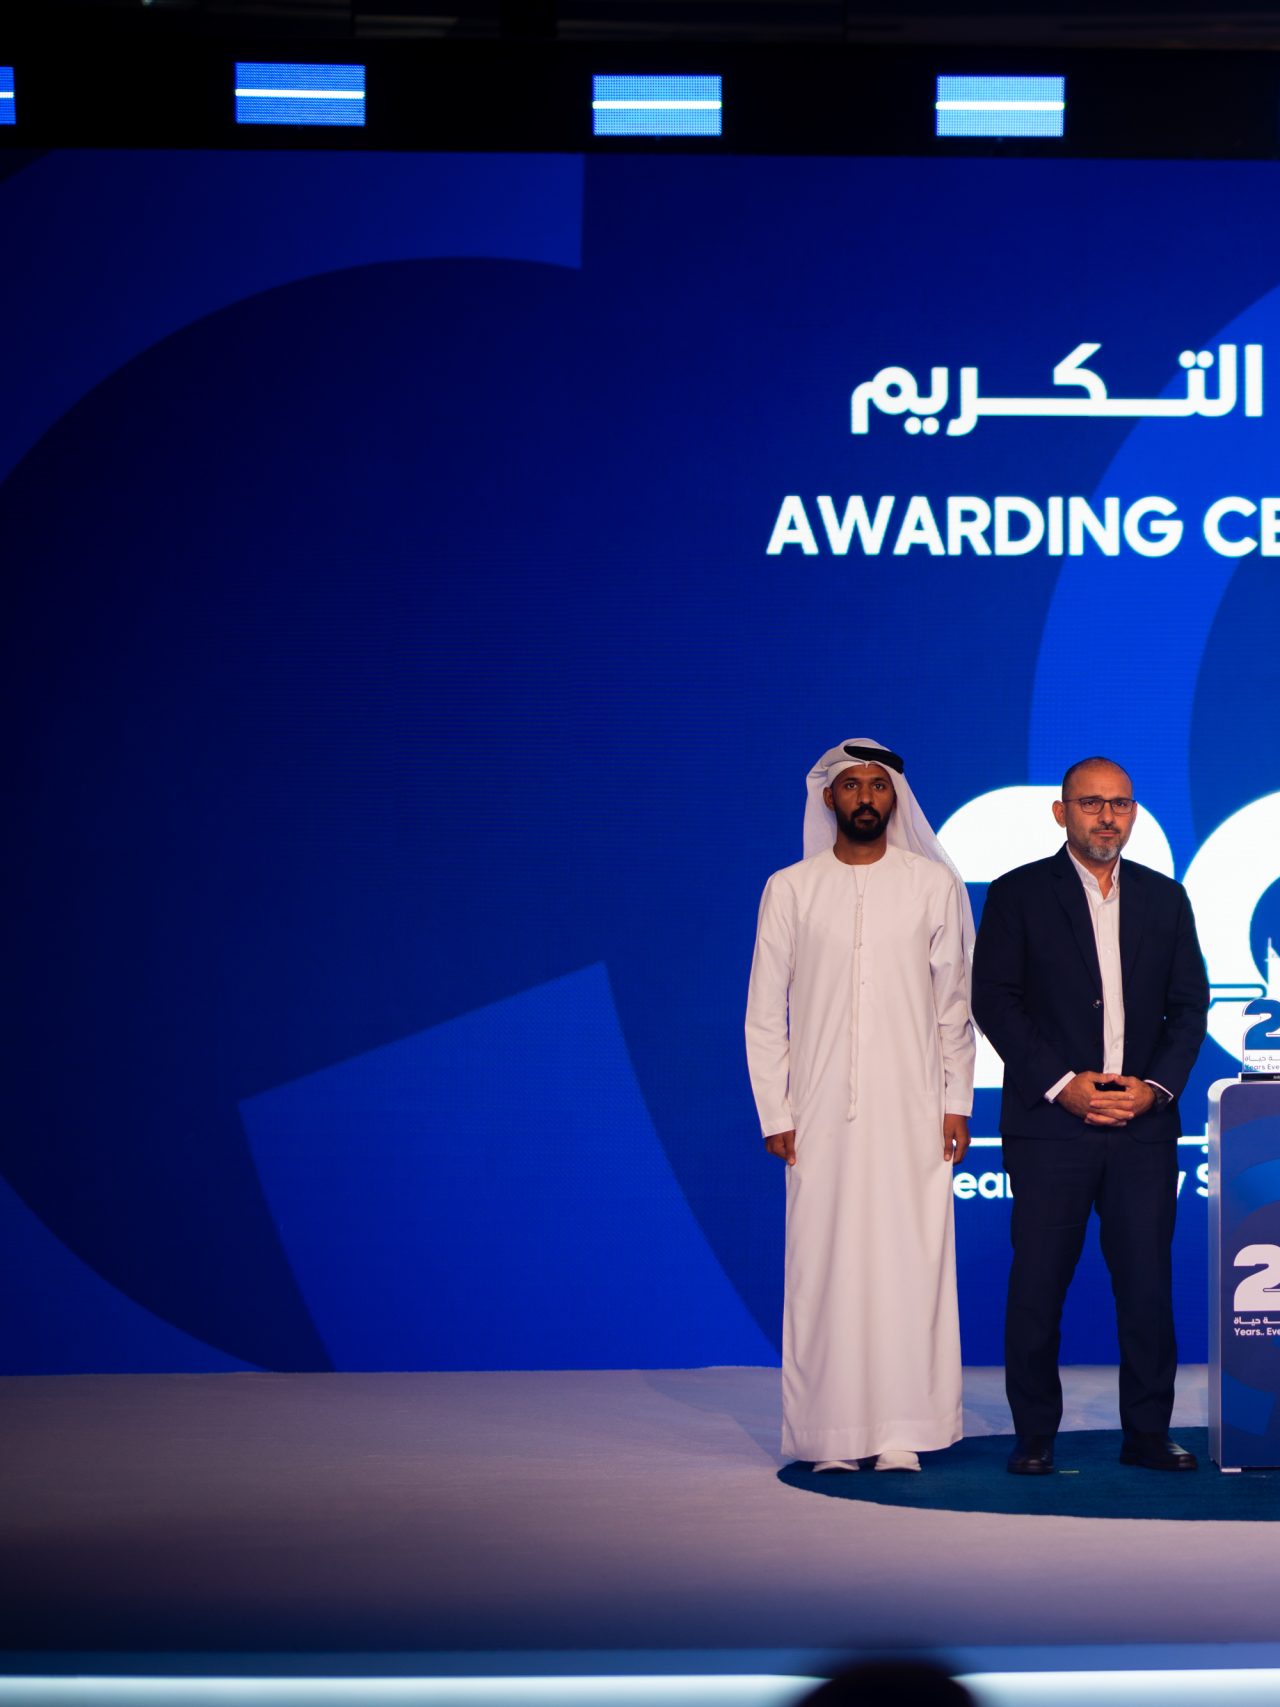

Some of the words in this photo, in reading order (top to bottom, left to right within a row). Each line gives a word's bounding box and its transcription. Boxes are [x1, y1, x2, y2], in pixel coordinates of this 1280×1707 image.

[850, 342, 1264, 437] التكريم
[766, 495, 1184, 557] AWARDING
[1233, 1316, 1261, 1327] حياة
